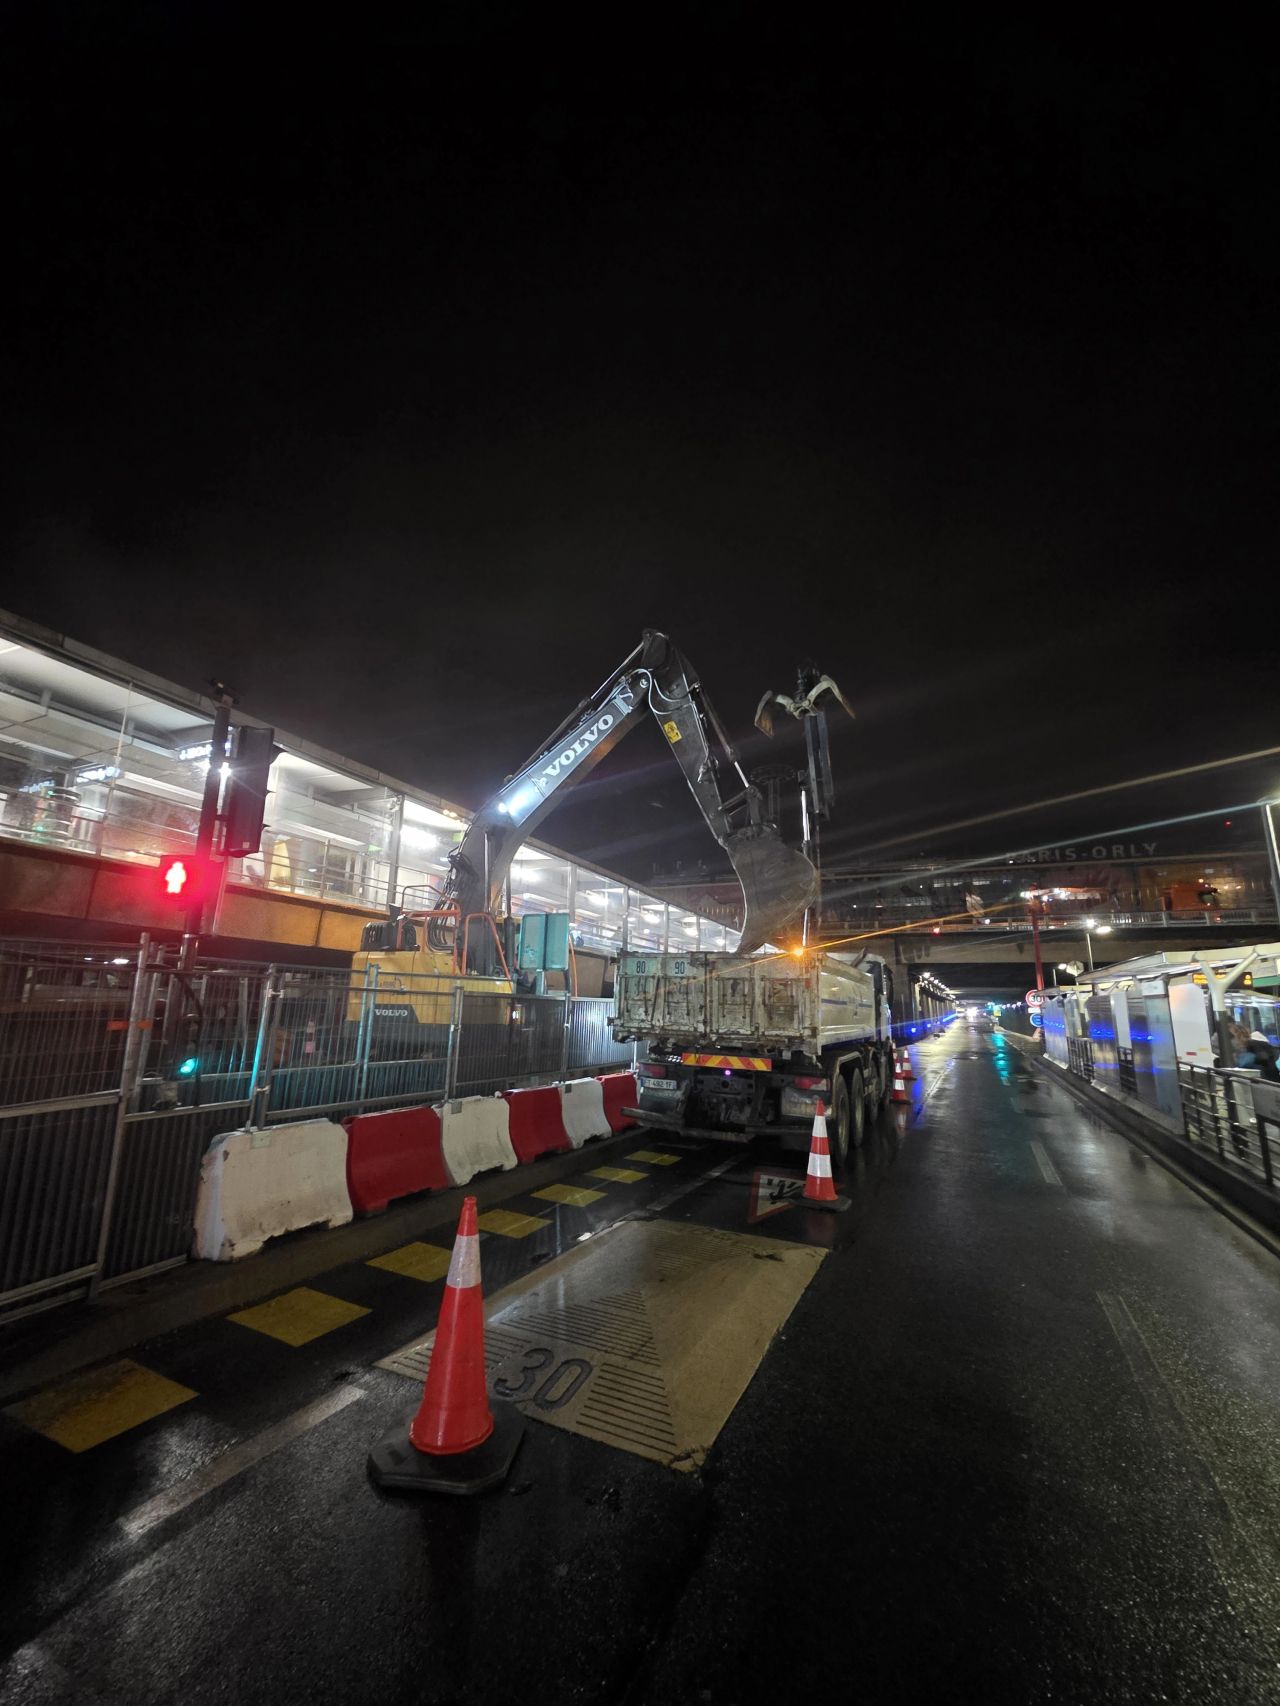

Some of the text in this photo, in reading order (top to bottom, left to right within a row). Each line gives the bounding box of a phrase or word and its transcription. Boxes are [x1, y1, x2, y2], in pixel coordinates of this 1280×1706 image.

[542, 714, 614, 777] VOLVO
[636, 961, 685, 975] 80 90
[374, 1008, 408, 1017] VOLVO
[494, 1348, 593, 1411] 30
